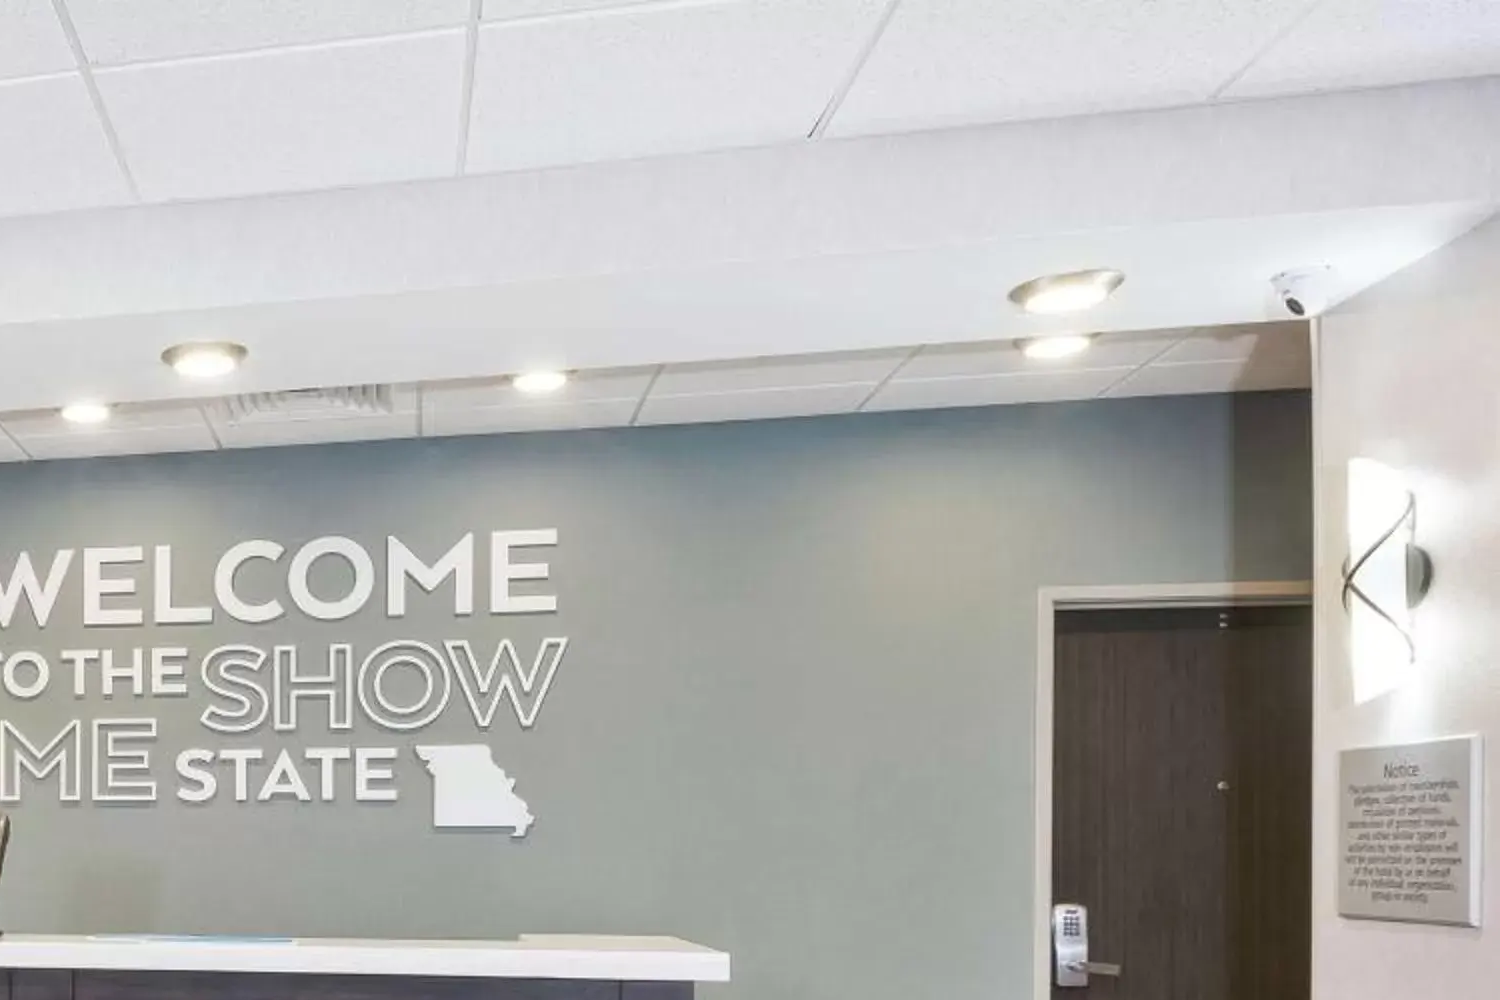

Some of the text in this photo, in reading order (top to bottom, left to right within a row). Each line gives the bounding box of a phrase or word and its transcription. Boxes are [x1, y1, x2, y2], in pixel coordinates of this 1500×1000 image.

[60, 647, 189, 697] THE
[200, 637, 569, 732] SHOW
[0, 718, 398, 802] ME STATE
[1384, 763, 1420, 778] Notice
